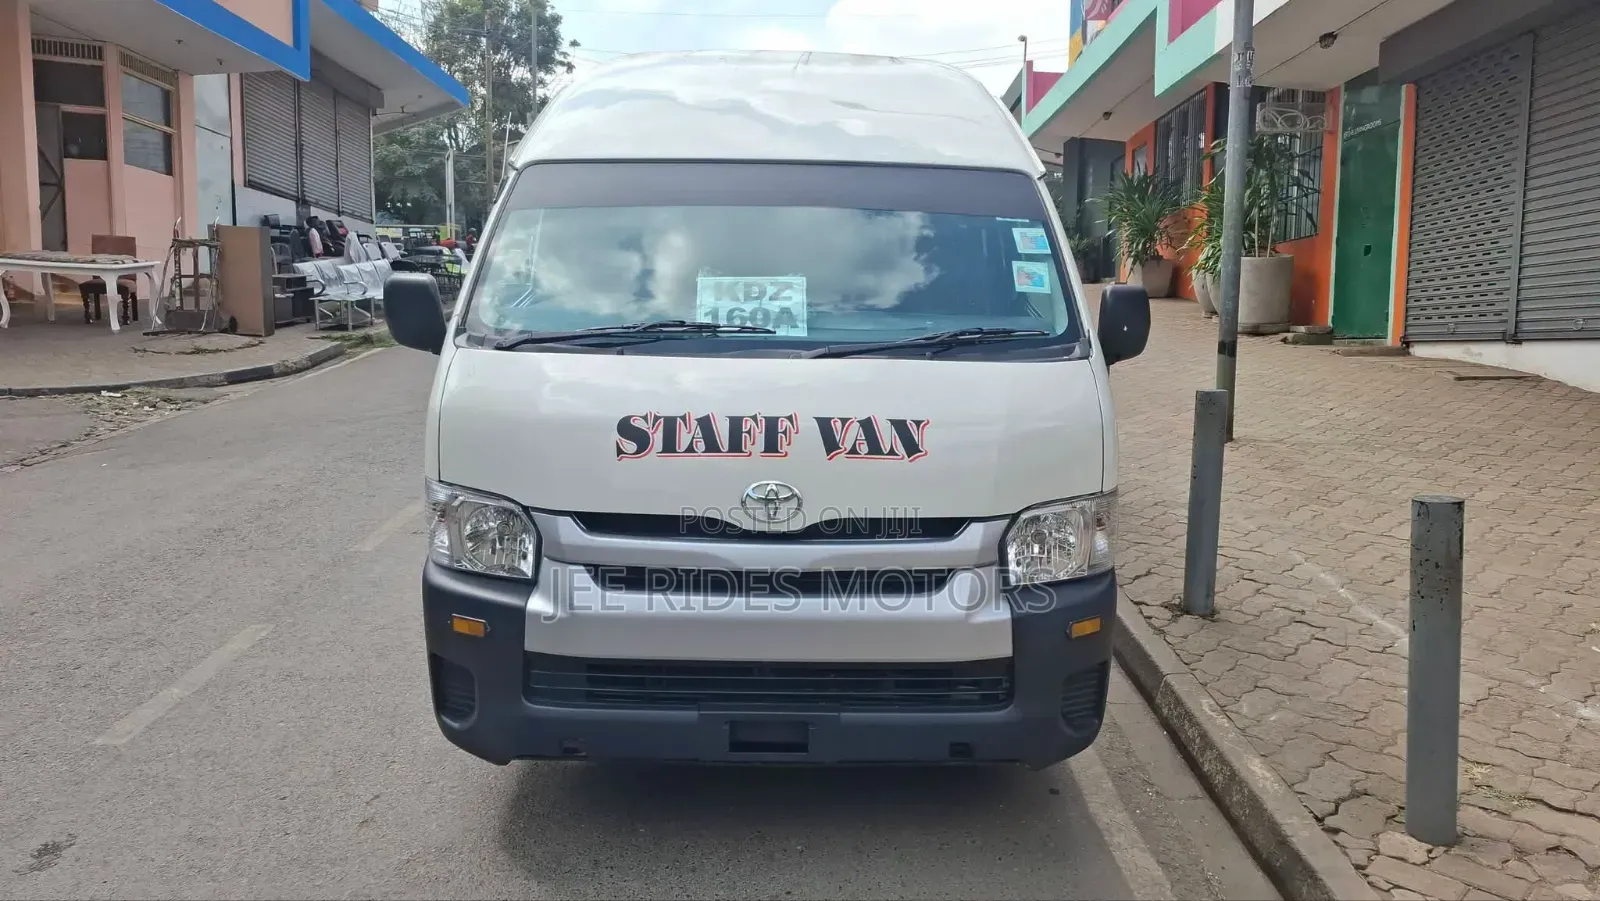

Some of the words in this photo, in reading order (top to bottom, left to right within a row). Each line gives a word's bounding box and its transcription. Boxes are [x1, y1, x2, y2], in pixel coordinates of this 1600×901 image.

[713, 281, 794, 302] KDZ
[703, 306, 800, 329] 160A
[615, 411, 800, 461] STAFF
[813, 414, 930, 463] VAN
